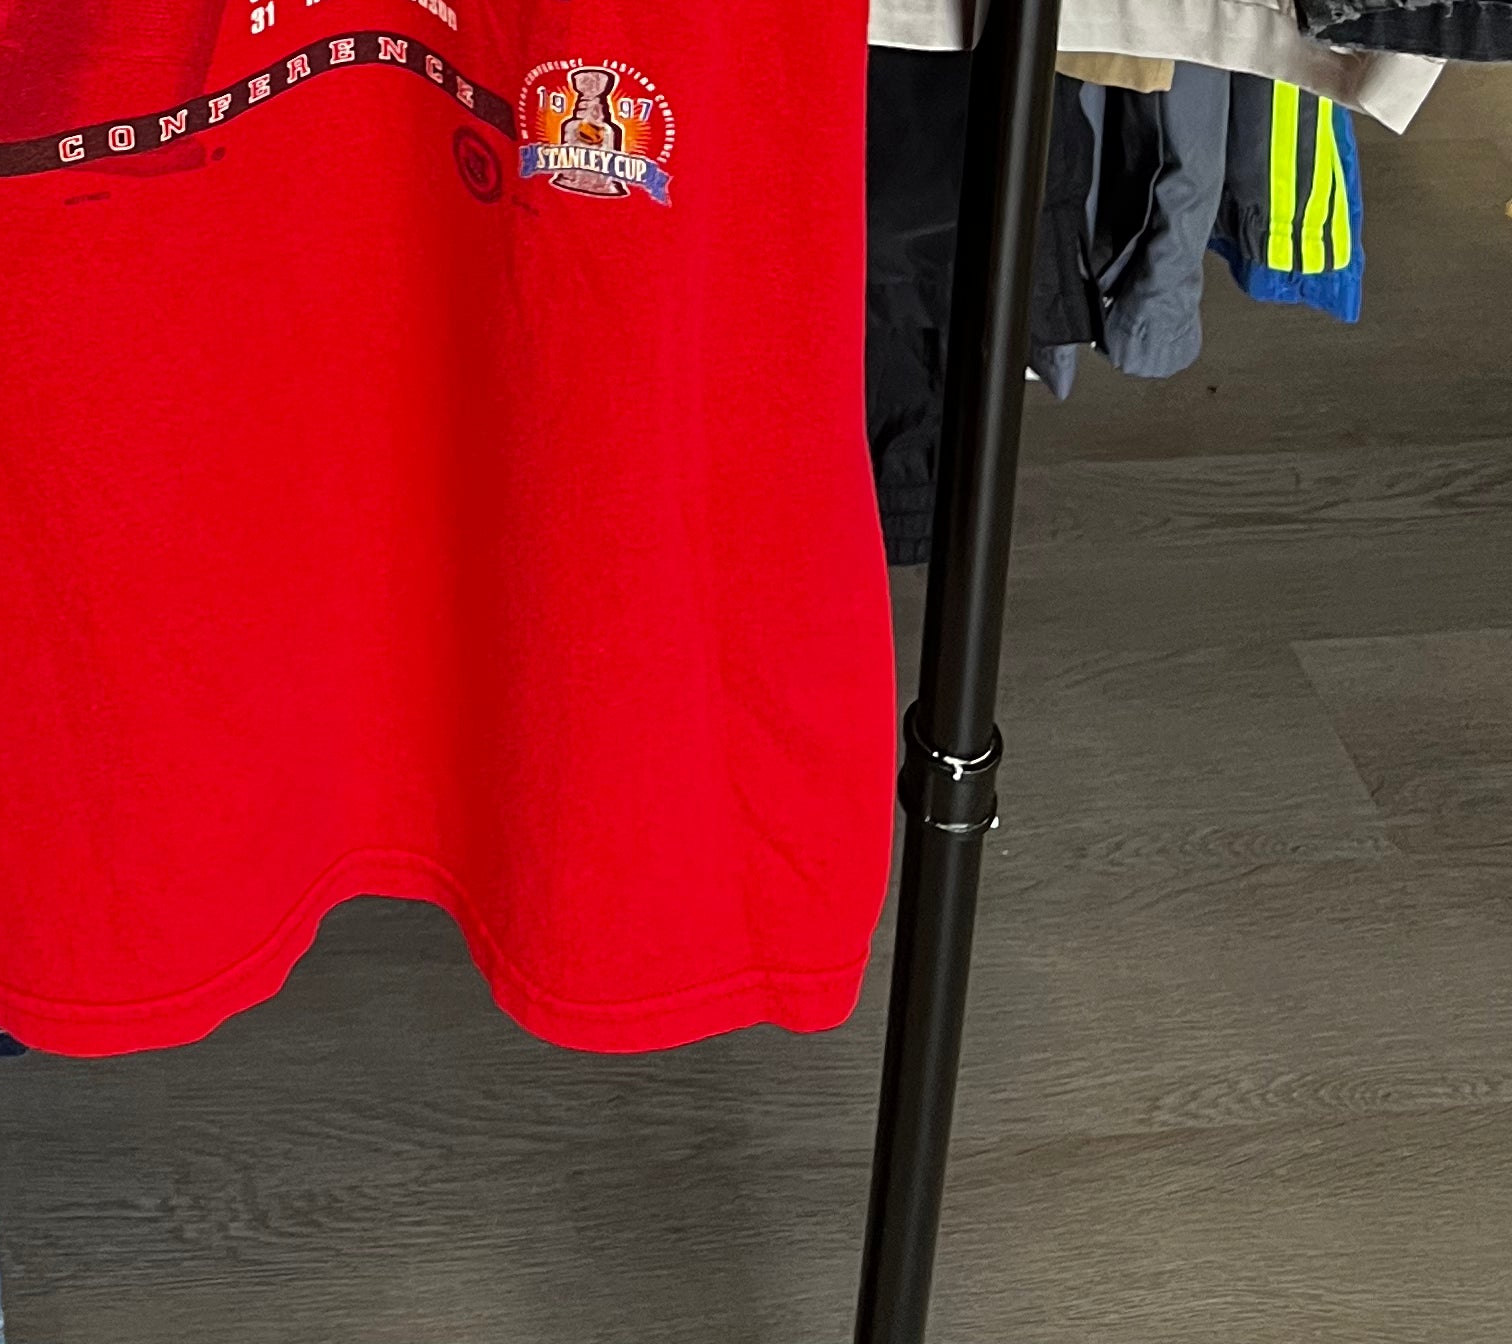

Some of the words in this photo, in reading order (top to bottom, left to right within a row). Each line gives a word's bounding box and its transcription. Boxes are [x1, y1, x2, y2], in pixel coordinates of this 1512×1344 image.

[251, 3, 276, 35] 31
[59, 36, 474, 163] CONFERENCE
[536, 146, 615, 175] STANLEY
[614, 151, 648, 183] CUP
